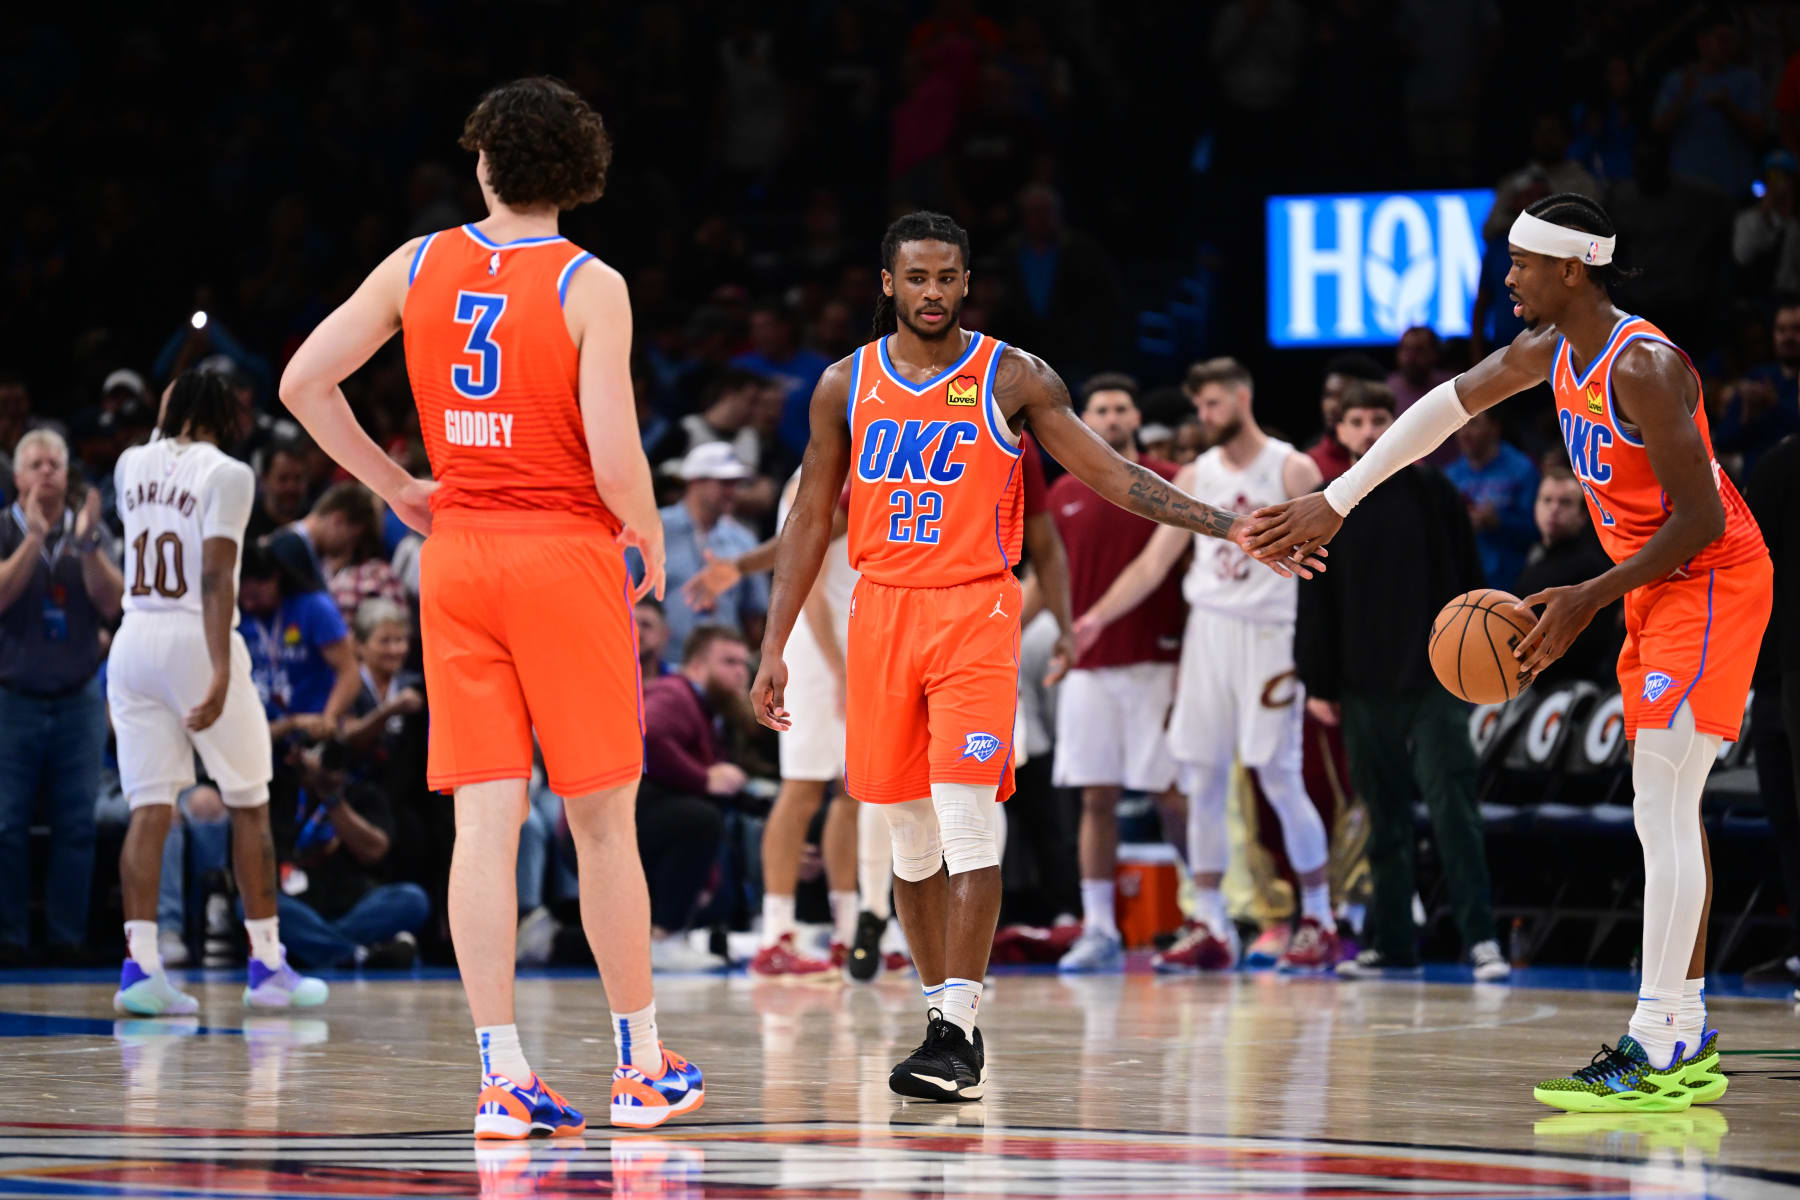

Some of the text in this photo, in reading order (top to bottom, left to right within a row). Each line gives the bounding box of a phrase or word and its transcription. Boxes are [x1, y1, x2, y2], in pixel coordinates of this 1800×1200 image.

[451, 290, 508, 400] 3
[444, 409, 514, 448] GIDDEY
[857, 418, 979, 486] OKC
[1559, 408, 1614, 485] OKC
[125, 480, 198, 519] GARLAND
[887, 489, 944, 545] 22
[130, 528, 188, 599] 10
[963, 739, 994, 755] OKC
